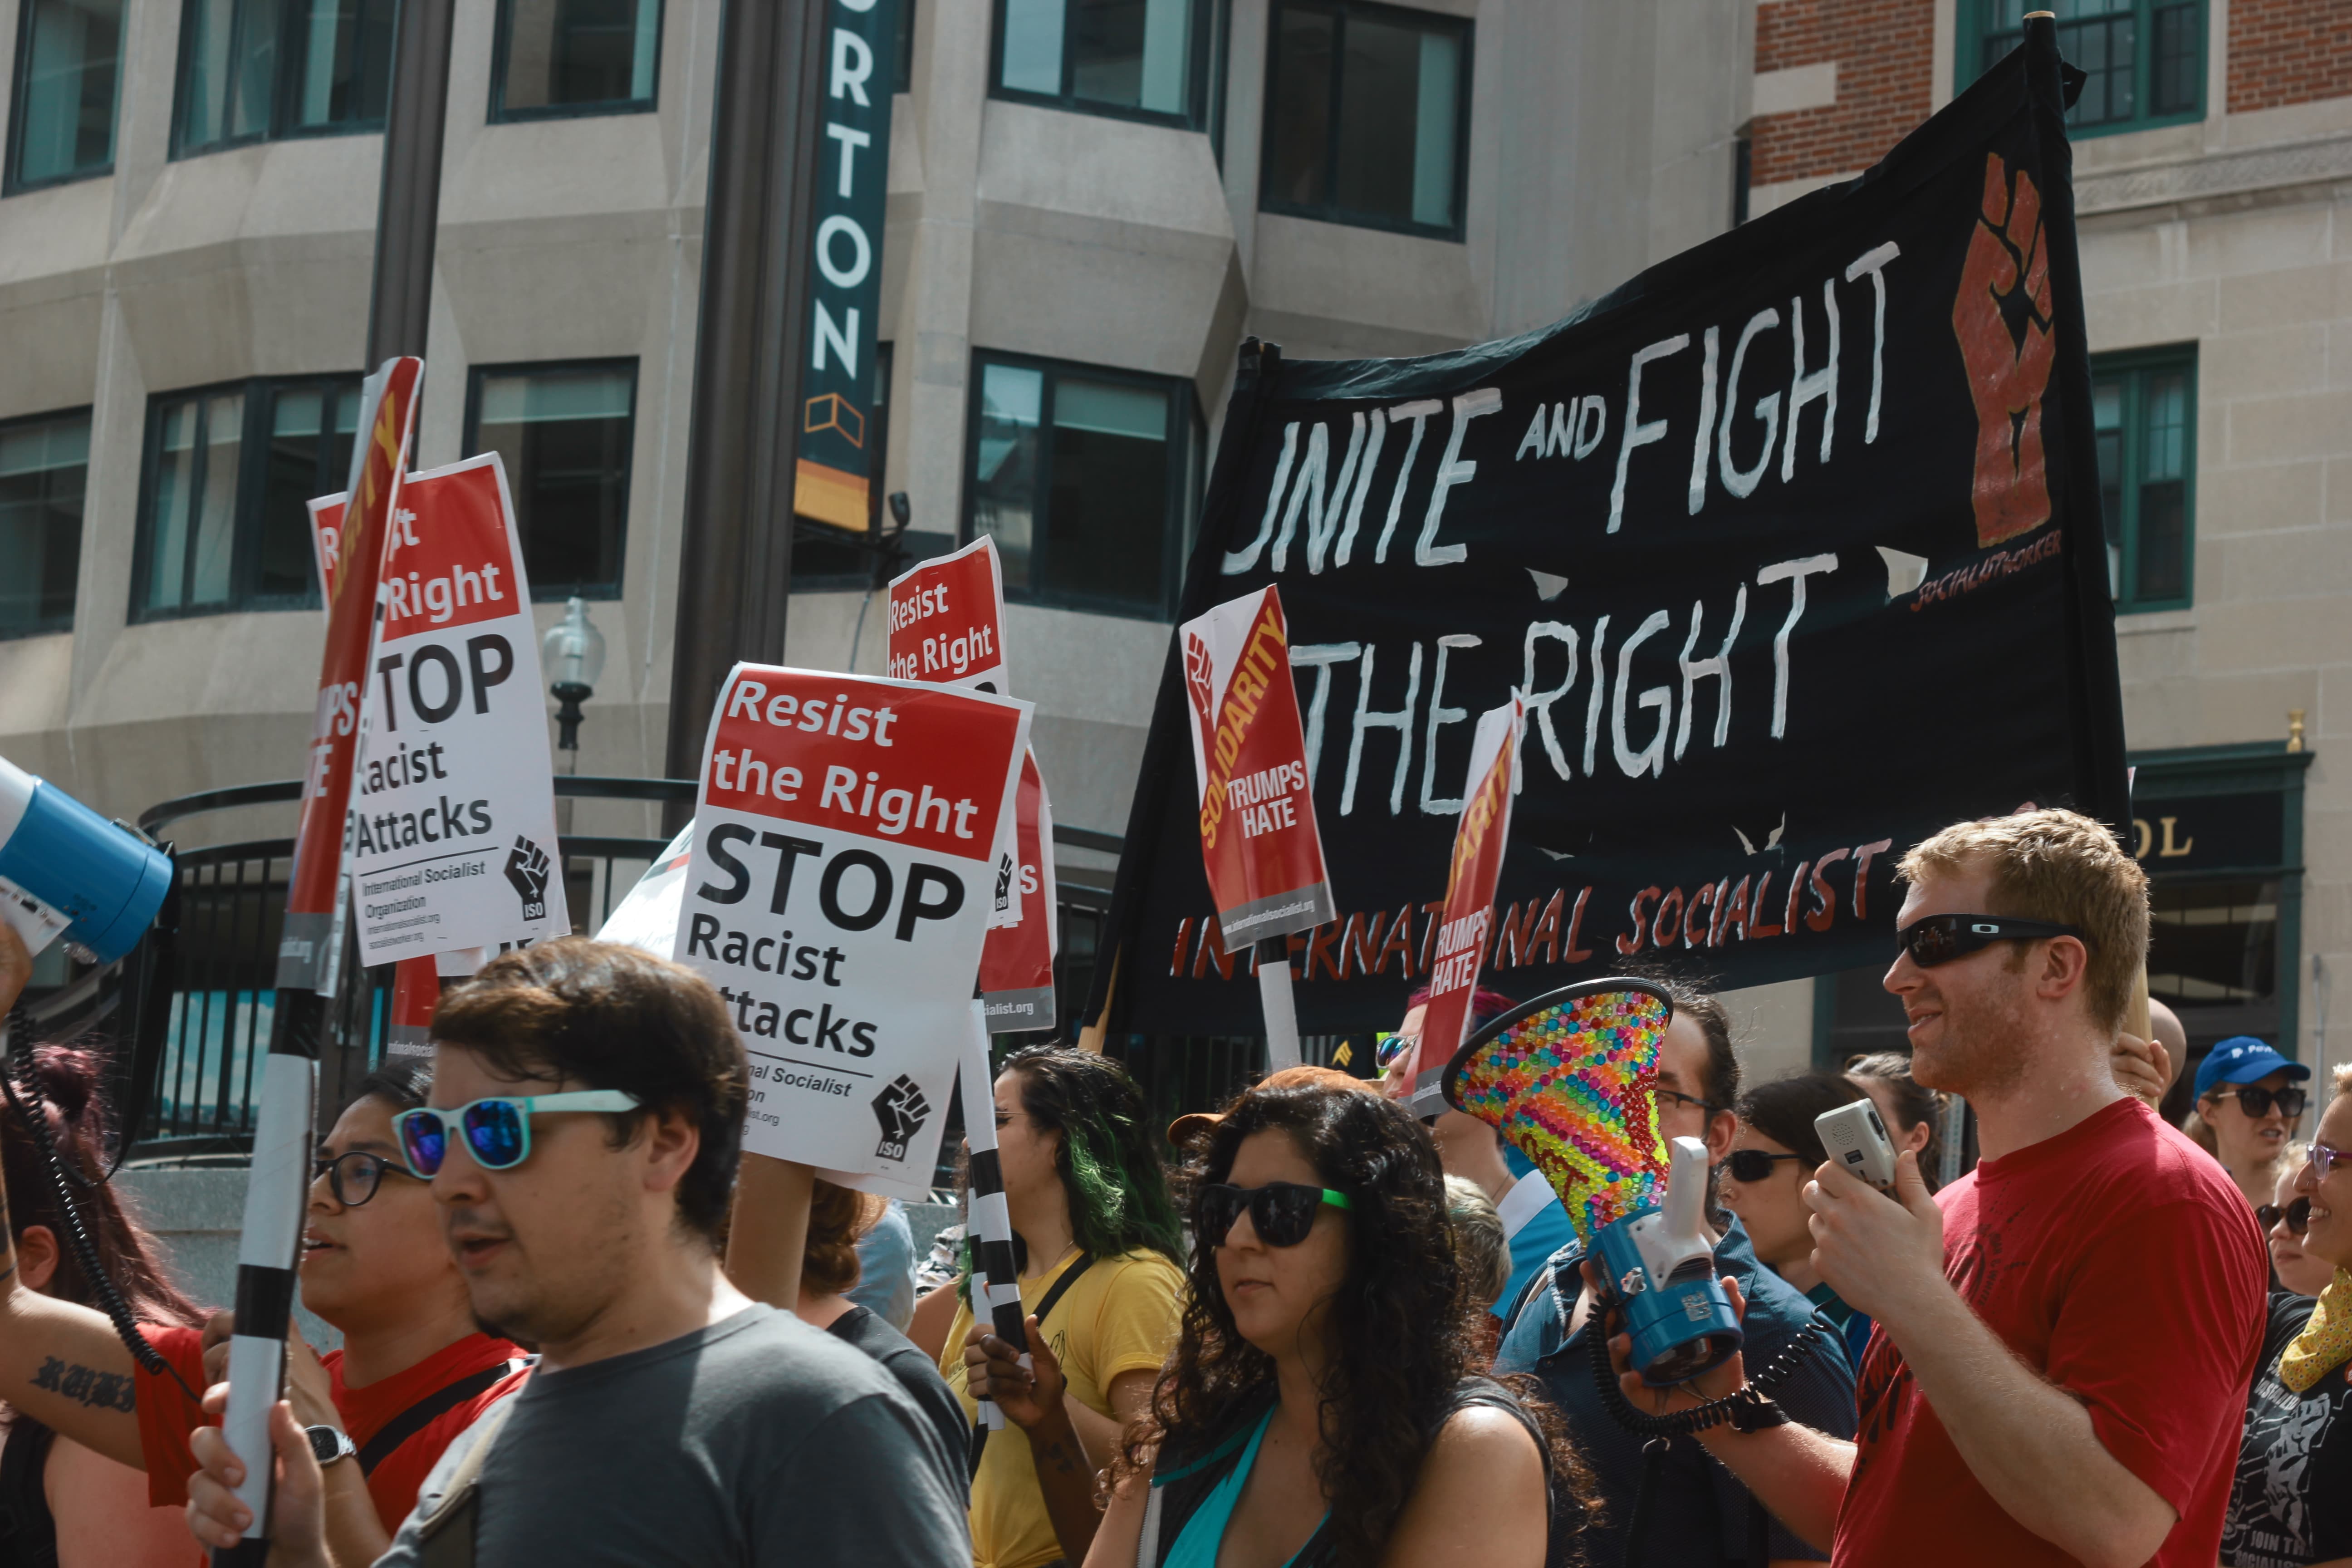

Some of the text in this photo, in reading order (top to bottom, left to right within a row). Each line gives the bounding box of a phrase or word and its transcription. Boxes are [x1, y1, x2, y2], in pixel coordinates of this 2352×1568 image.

[812, 0, 876, 380] RTON
[1515, 395, 1607, 461] AND
[1606, 240, 1901, 534] FIGHT
[388, 562, 505, 624] Right
[890, 583, 949, 635] Resist
[889, 623, 994, 680] the Right
[377, 633, 514, 732] TOP
[1289, 552, 1839, 816] THE RIGHT
[727, 680, 898, 747] Resist
[1200, 605, 1287, 850] SOLIDARITY
[363, 740, 448, 796] acist
[713, 749, 978, 839] the Right
[1225, 760, 1306, 812] TRUMPS
[356, 794, 494, 858] Attacks
[1241, 796, 1298, 839] HATE
[424, 861, 486, 883] Socialist
[697, 823, 965, 943] STOP
[1616, 838, 1892, 955] SOCIALIST
[524, 902, 544, 918] ISO
[996, 896, 1007, 909] ISO
[687, 912, 846, 988] Racist
[1434, 905, 1490, 961] RUMPS
[1429, 950, 1476, 999] HATE
[772, 1067, 853, 1097] Socialist
[878, 1141, 904, 1158] ISO
